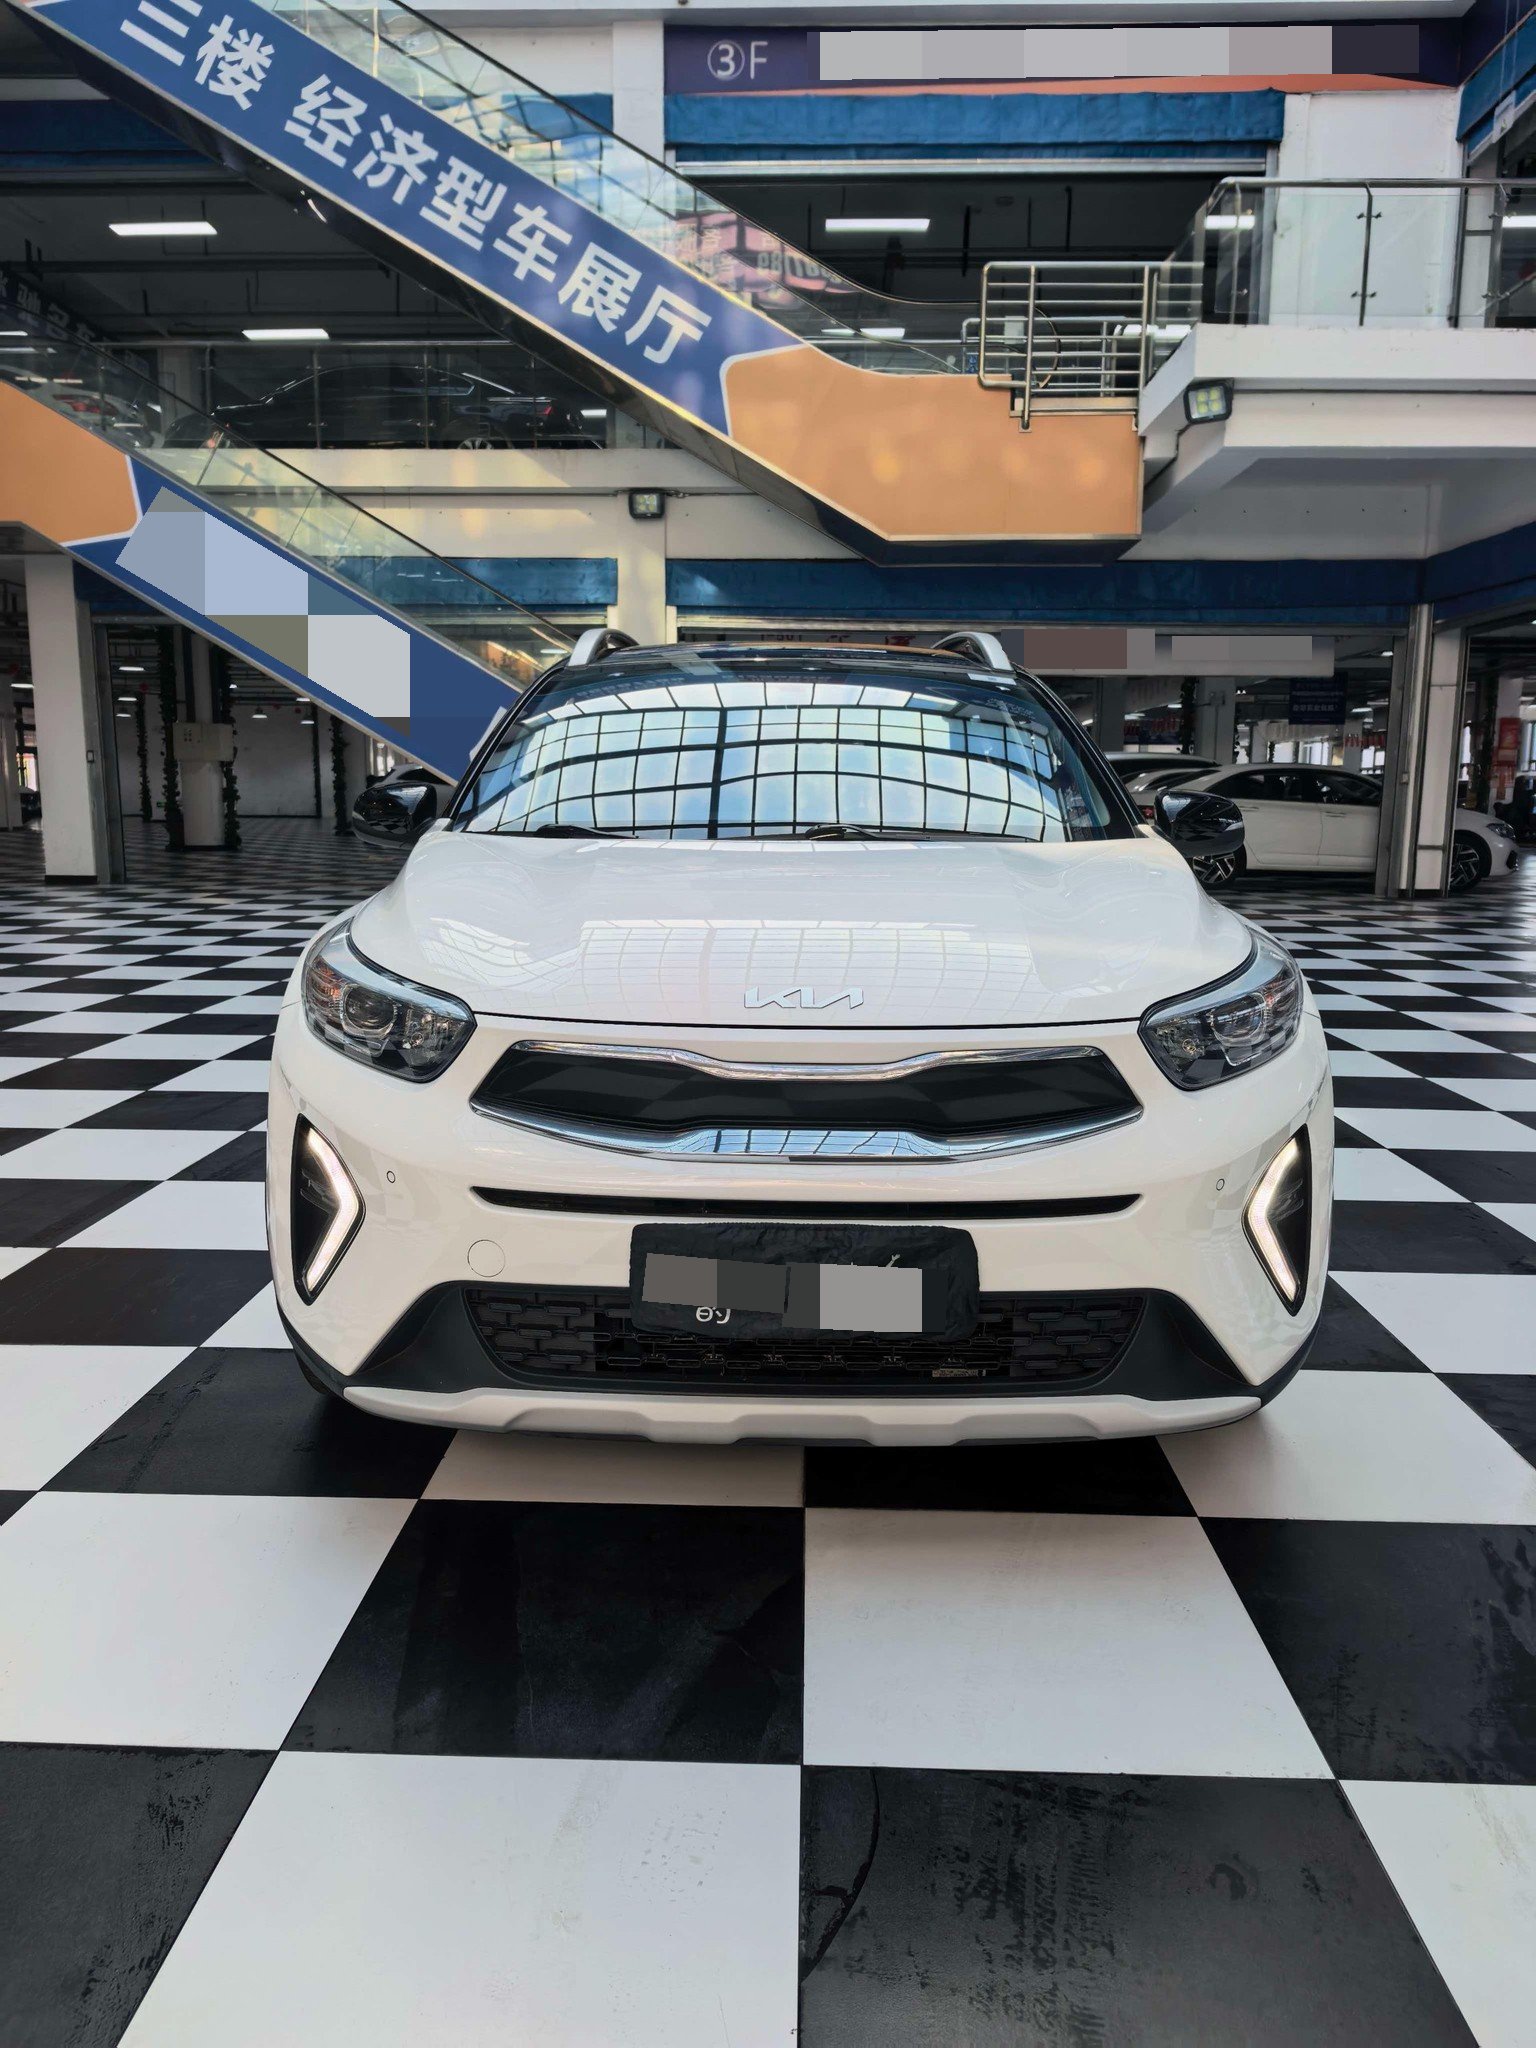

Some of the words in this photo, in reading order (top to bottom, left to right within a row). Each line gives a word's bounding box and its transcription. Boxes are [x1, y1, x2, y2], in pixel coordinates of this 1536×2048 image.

[120, 0, 275, 111] 三楼
[283, 73, 712, 365] 经济型车展厅
[744, 985, 864, 1010] KIA
